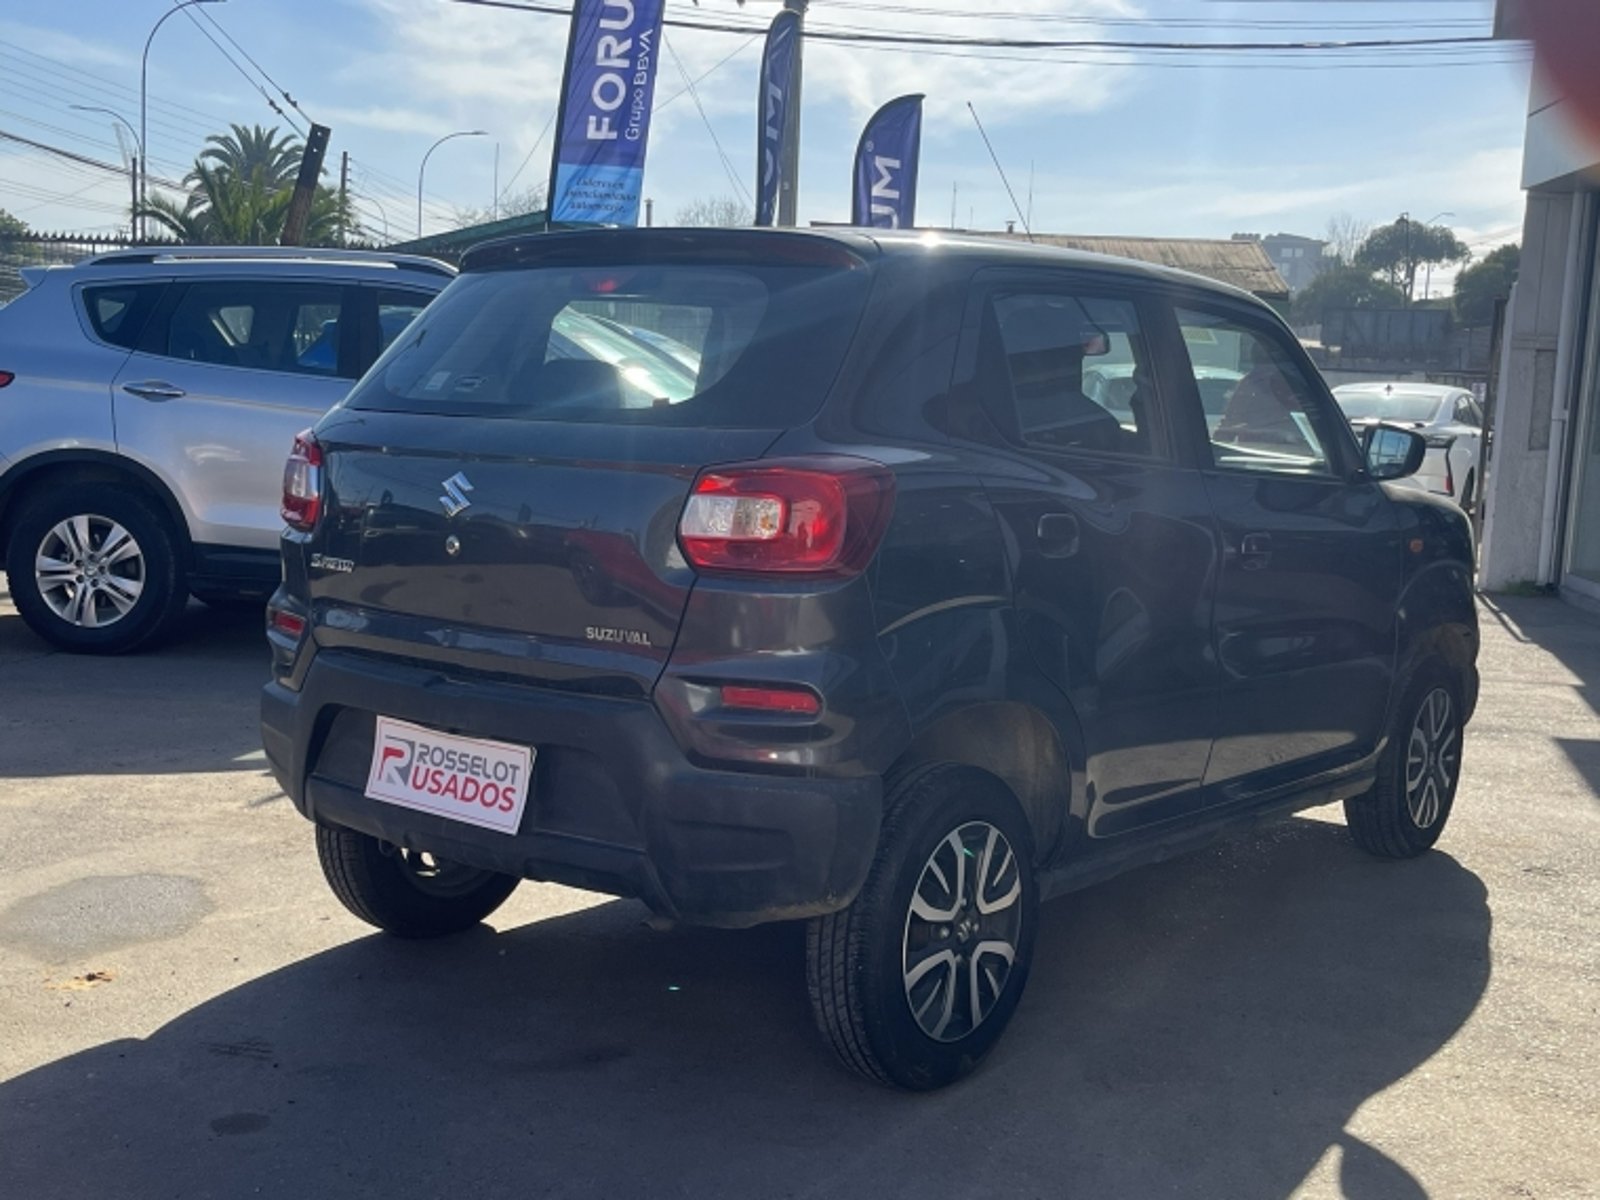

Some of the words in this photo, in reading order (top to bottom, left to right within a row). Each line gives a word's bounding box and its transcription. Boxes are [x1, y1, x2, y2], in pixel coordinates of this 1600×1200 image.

[633, 28, 654, 86] BBVA
[624, 88, 645, 141] Grupo
[585, 626, 651, 646] SUZUVAL
[416, 743, 521, 785] ROSSELOT
[411, 766, 517, 813] USADOS
